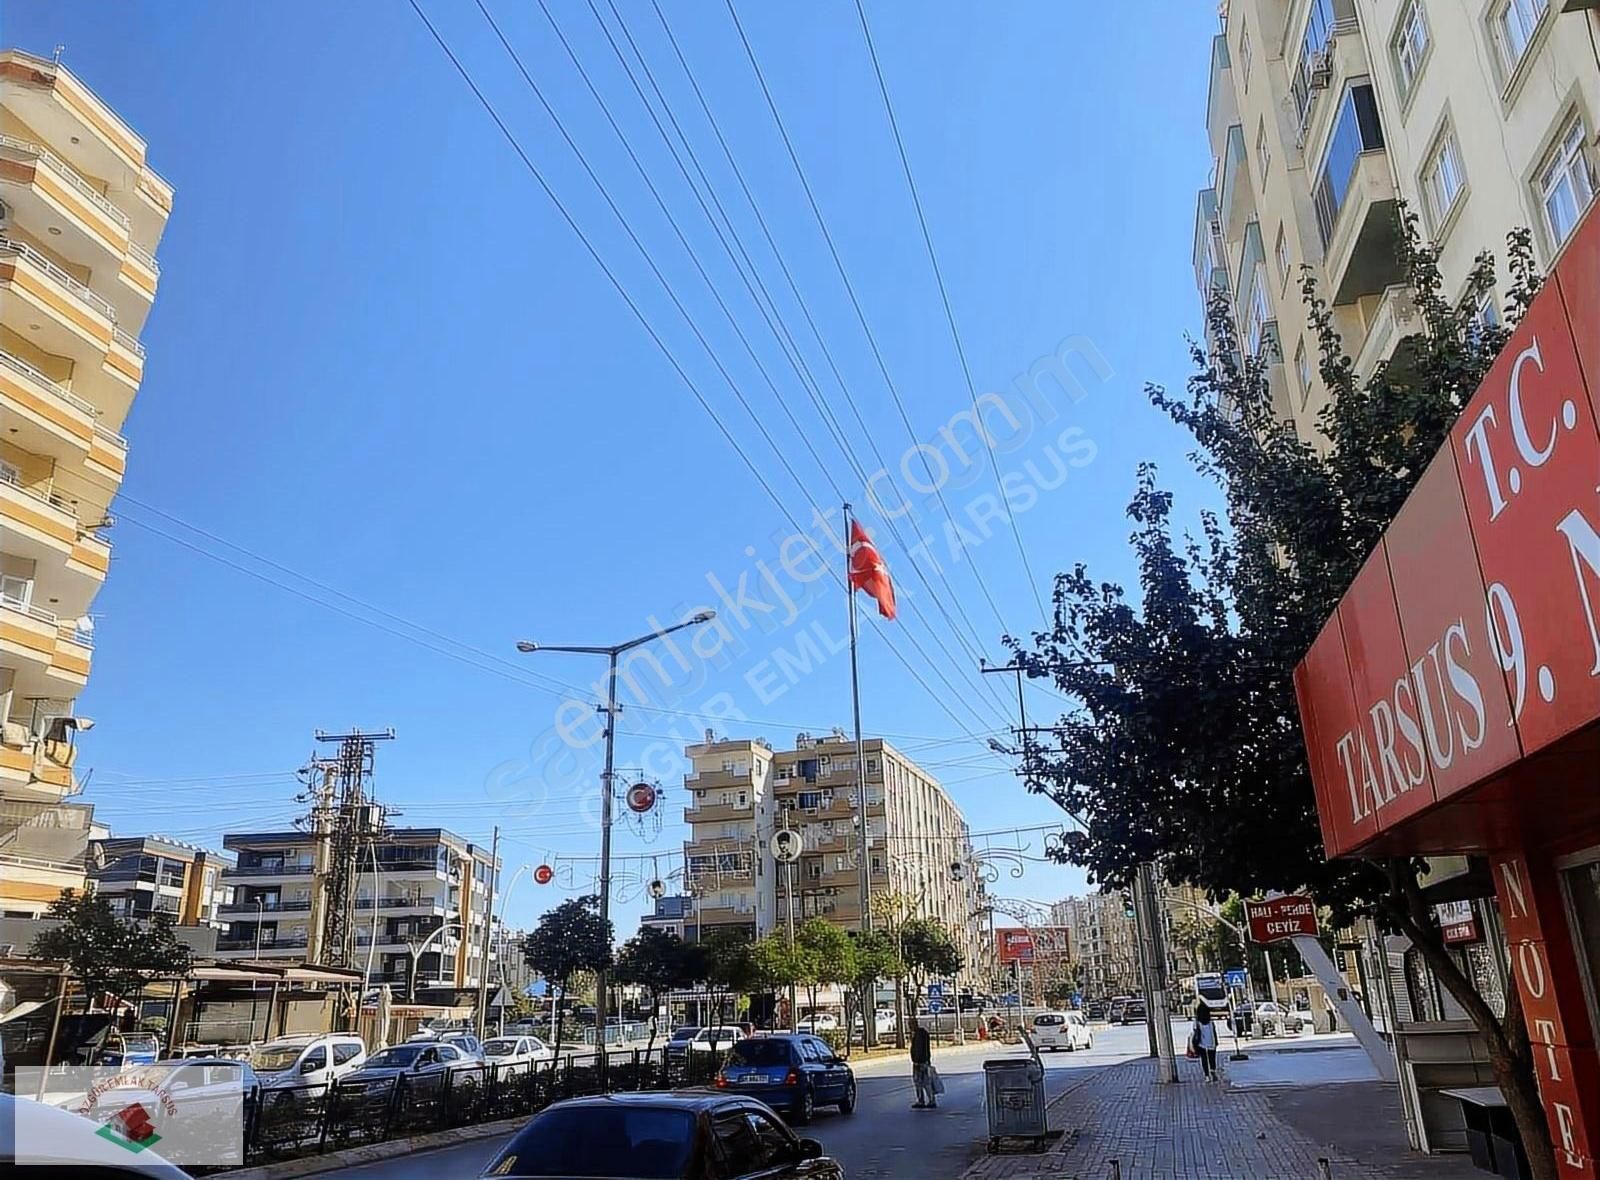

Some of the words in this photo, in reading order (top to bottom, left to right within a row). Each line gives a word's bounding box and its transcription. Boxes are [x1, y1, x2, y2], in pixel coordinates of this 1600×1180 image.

[1465, 335, 1578, 523] T.C.
[1336, 615, 1488, 825] TARSUS
[1486, 582, 1556, 728] 9.
[1250, 906, 1272, 919] HALI
